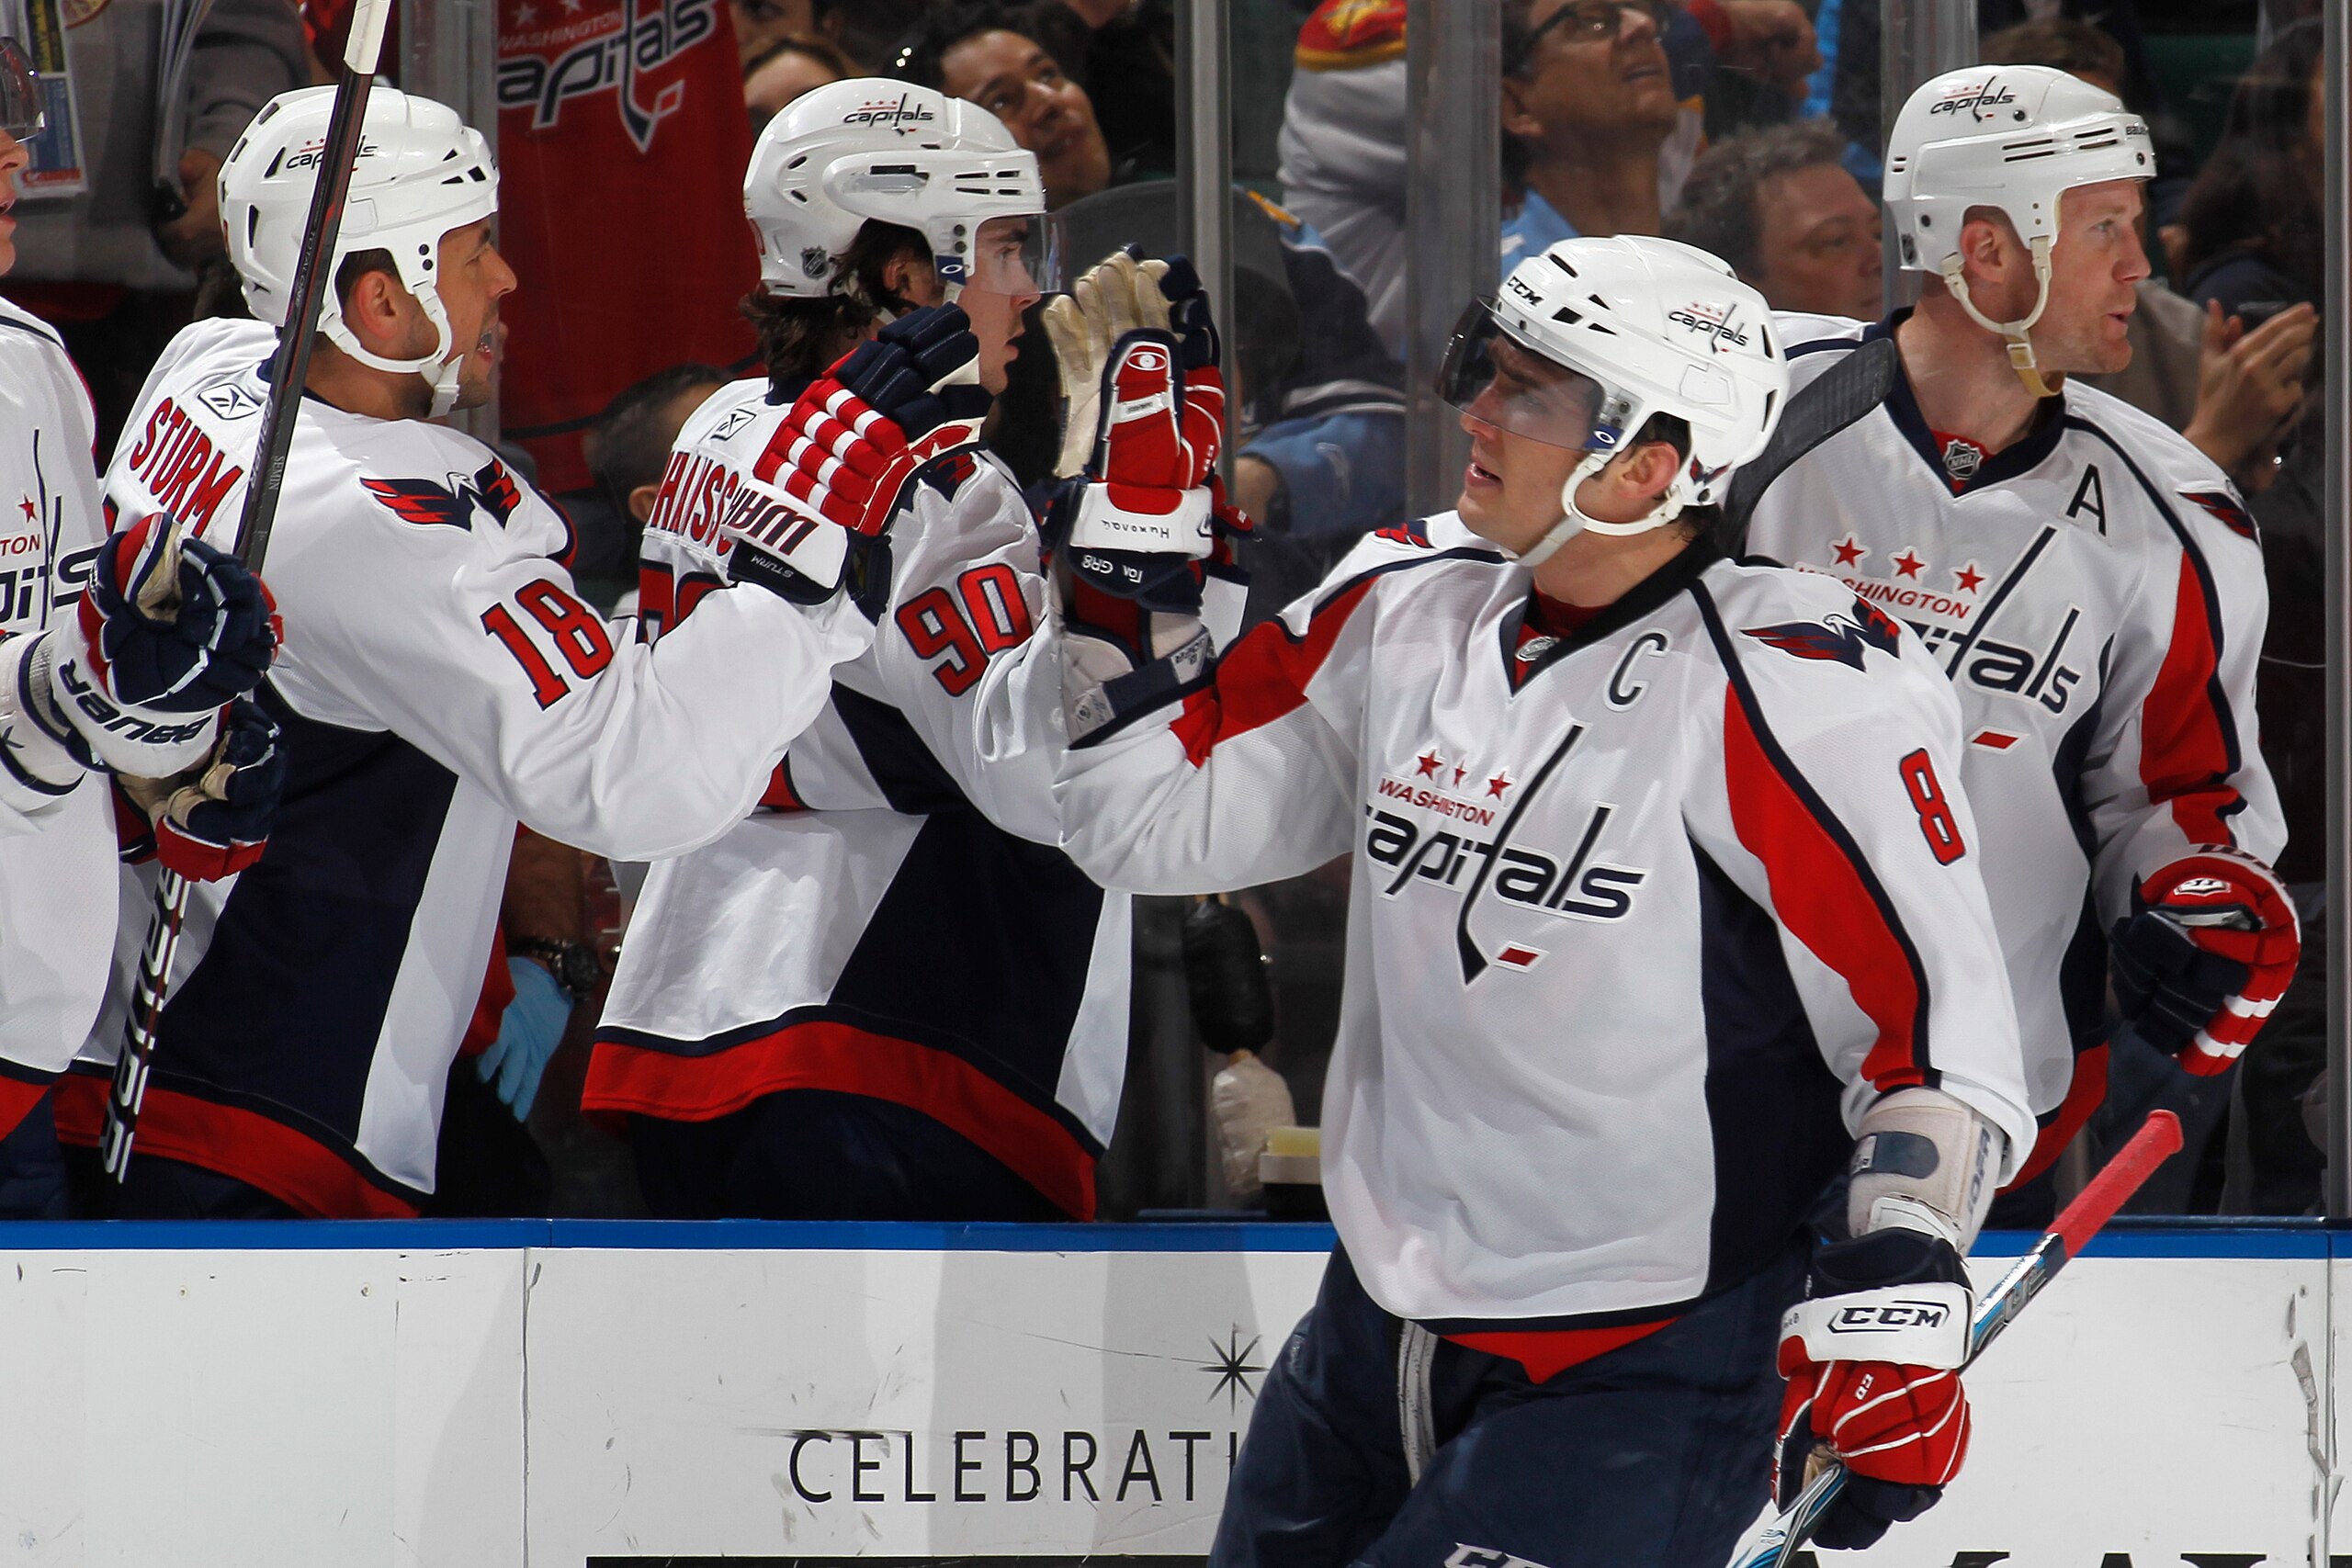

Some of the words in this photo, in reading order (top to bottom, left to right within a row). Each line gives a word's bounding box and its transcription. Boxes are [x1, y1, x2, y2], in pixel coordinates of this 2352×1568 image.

[498, 0, 717, 150] apitals
[1930, 75, 2017, 122] capitals
[843, 93, 934, 136] capitals
[1668, 304, 1749, 354] capitals
[130, 396, 244, 540] STURM
[268, 455, 286, 491] SEMIN
[2065, 462, 2107, 537] A
[751, 554, 795, 580] STURM
[1080, 554, 1114, 575] GR8
[480, 578, 614, 711] 18
[894, 562, 1034, 698] 90
[1609, 632, 1668, 705] C
[1899, 748, 1966, 866] 8
[1366, 724, 1646, 987] apitals
[1841, 1307, 1943, 1328] CCM
